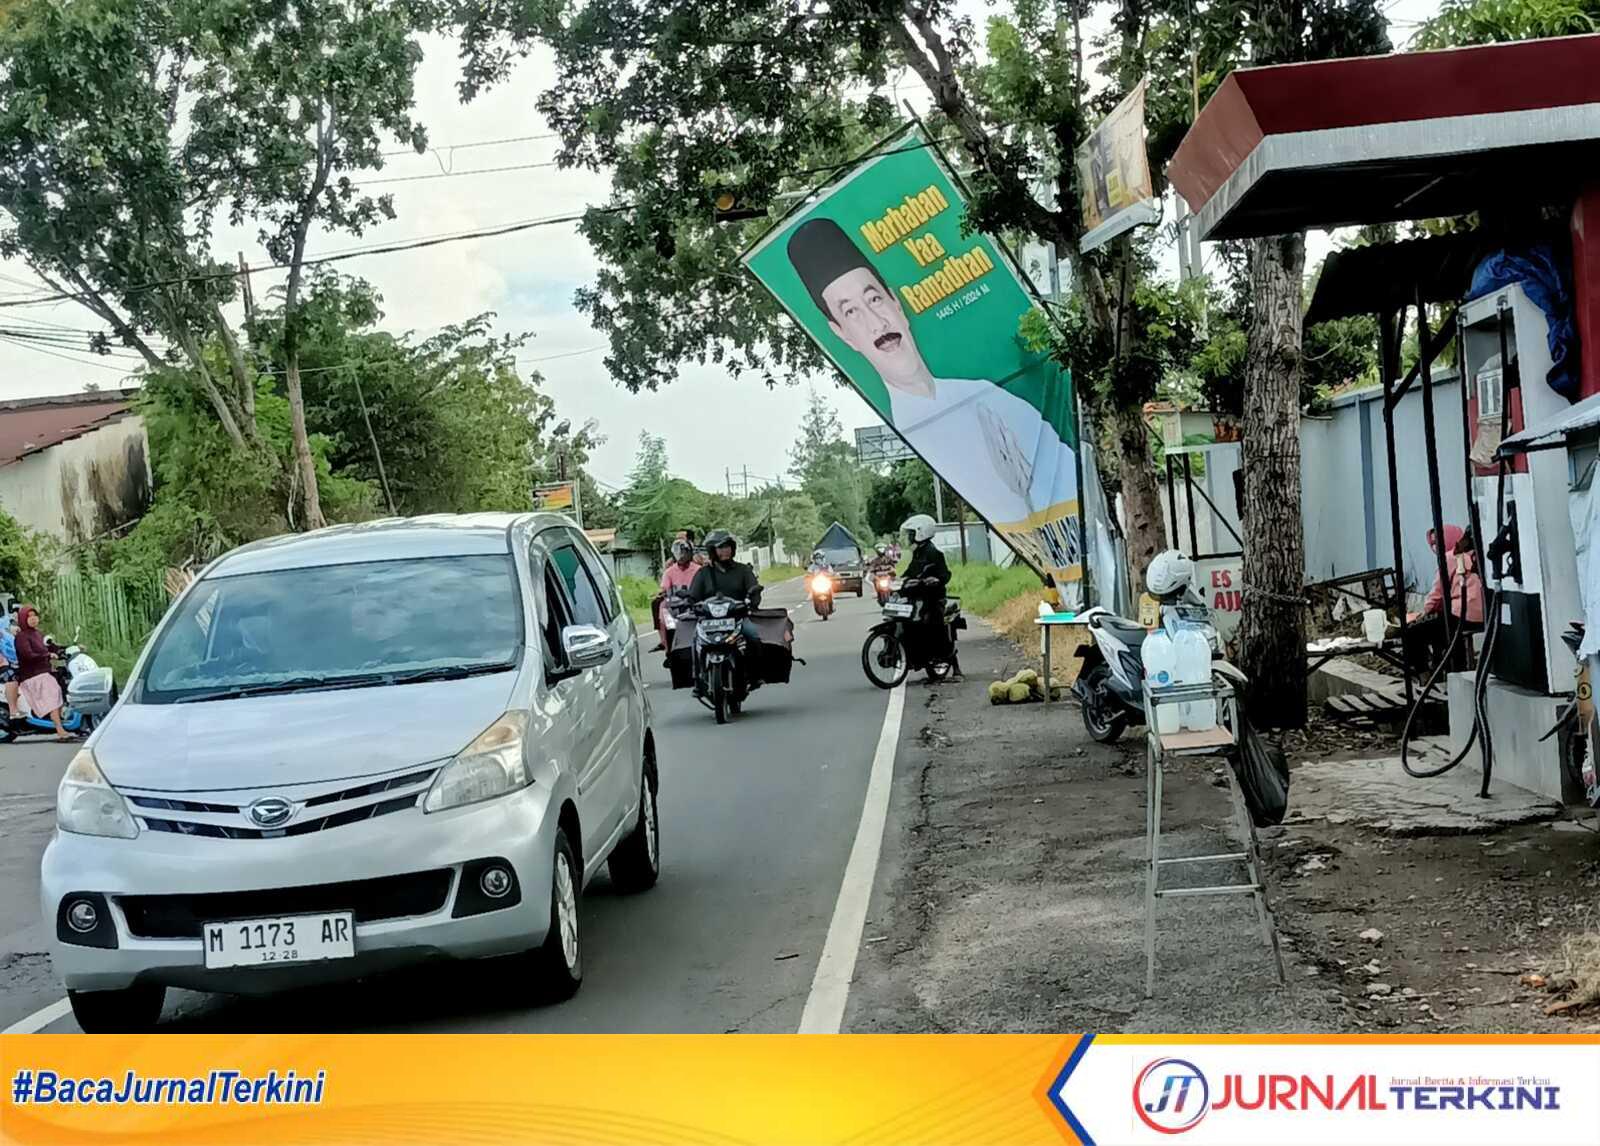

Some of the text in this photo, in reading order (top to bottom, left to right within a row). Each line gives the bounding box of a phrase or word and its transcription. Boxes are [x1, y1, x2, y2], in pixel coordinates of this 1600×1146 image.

[860, 185, 949, 253] Marhaban
[903, 233, 945, 267] Yaa
[900, 246, 994, 313] Ramadhan
[936, 304, 954, 320] 1445
[951, 299, 961, 311] H
[1211, 569, 1232, 588] ES
[210, 918, 349, 952] M 1173 AR
